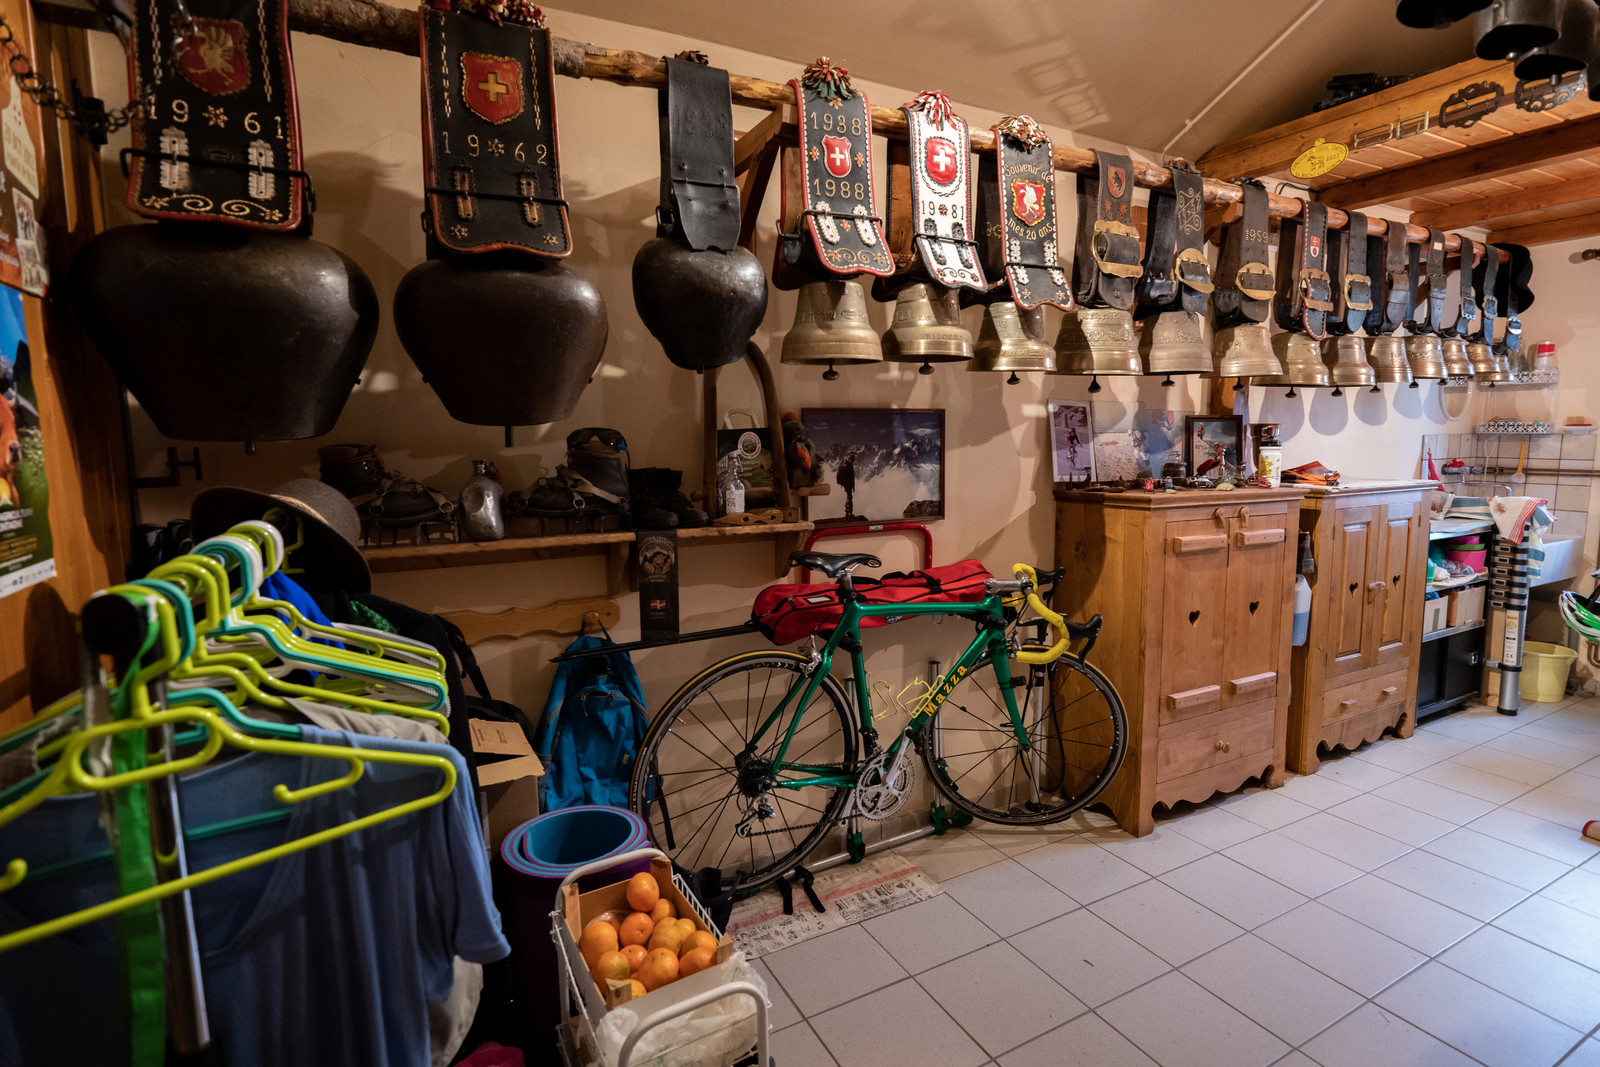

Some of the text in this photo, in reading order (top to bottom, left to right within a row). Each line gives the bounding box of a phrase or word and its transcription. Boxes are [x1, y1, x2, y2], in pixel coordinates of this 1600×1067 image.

[810, 111, 862, 136] 1938
[1003, 163, 1051, 183] Souvenir de
[813, 178, 864, 200] 1988
[1007, 217, 1053, 240] mes 20 ans
[1244, 228, 1268, 244] 1959
[923, 665, 968, 718] Mazza
